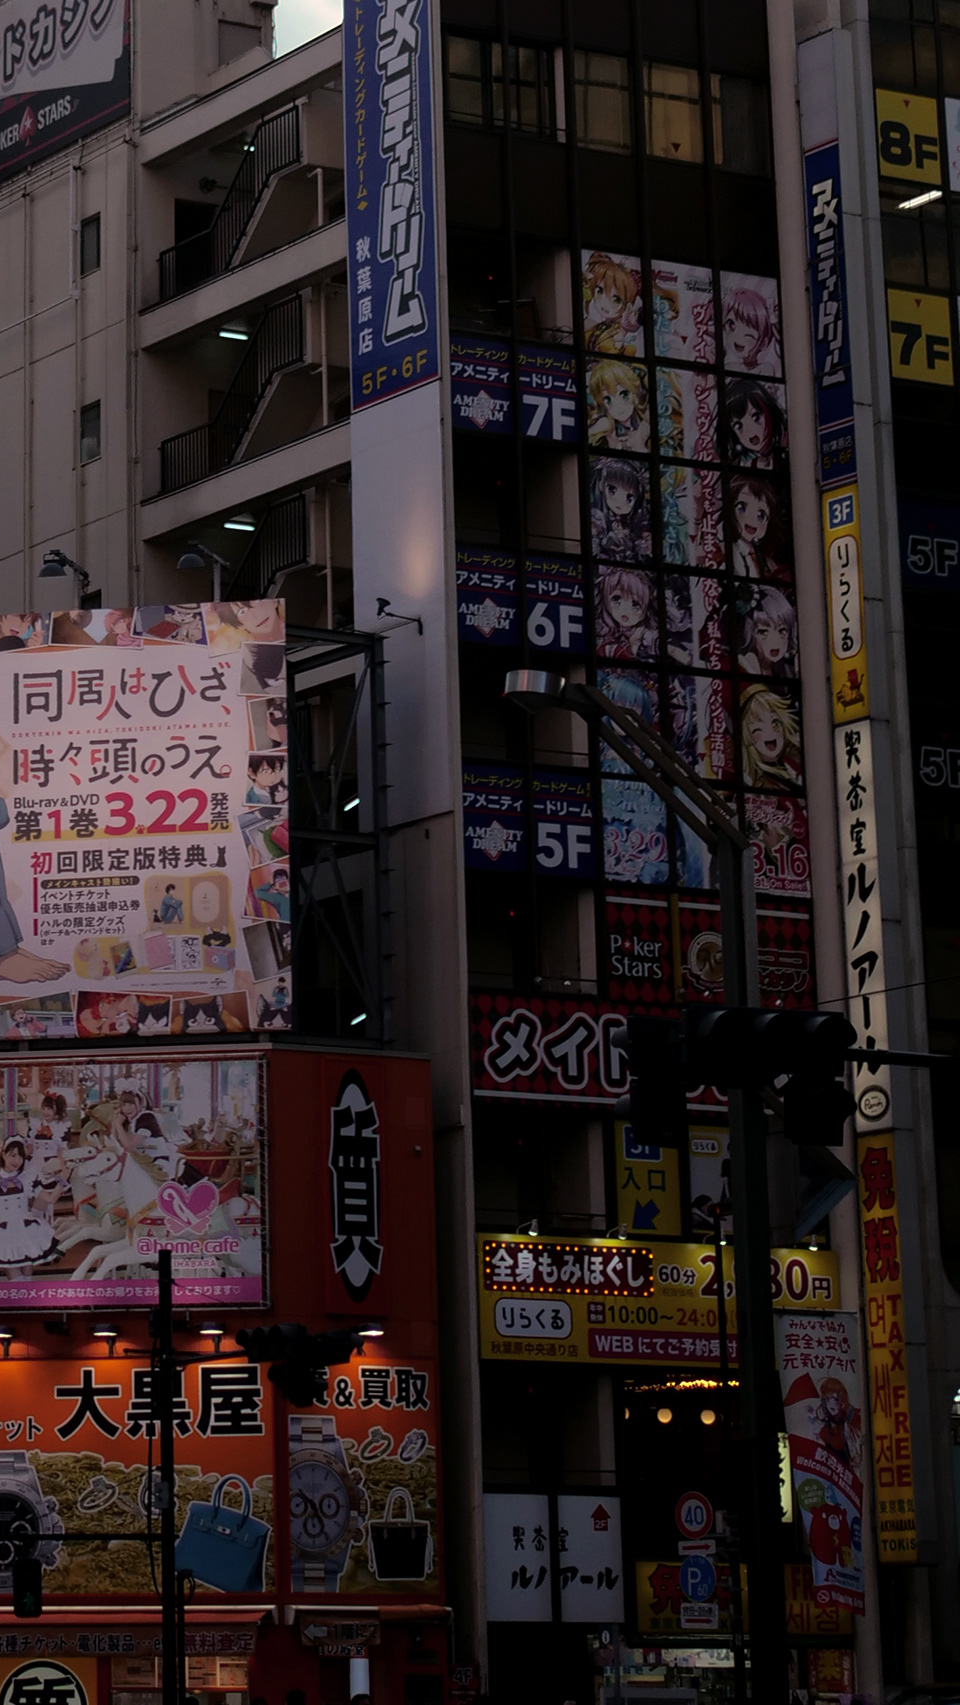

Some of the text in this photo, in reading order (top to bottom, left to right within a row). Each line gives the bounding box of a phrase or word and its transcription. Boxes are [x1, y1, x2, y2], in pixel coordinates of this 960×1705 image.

[37, 96, 71, 130] STARS
[880, 121, 938, 169] 8F
[890, 321, 950, 369] 7F
[522, 394, 576, 441] 7F
[831, 499, 852, 524] 3F
[906, 534, 959, 577] 5F
[837, 542, 854, 652] りらくる
[526, 602, 584, 648] 6F
[14, 788, 229, 841] 第1巻 3.22 発売
[30, 845, 208, 875] 初回限定版特典
[536, 822, 592, 869] 5F
[605, 827, 667, 863] 3.29
[41, 889, 111, 902] イベントチケット
[41, 915, 125, 928] ハルの限定グッズ
[611, 955, 663, 979] Stars
[621, 1167, 666, 1192] 入口
[861, 1146, 900, 1284] 免税
[491, 1248, 646, 1288] 全身もみほぐし
[657, 1265, 697, 1285] 60分
[501, 1307, 565, 1331] りらくる
[594, 1334, 635, 1353] WEB
[783, 1353, 856, 1374] 元気なアキバ
[54, 1367, 265, 1440] 大黒屋
[311, 1364, 430, 1412] &買取
[886, 1294, 913, 1488] TAX FREE
[594, 1519, 608, 1529] 2F
[684, 1504, 704, 1526] 40
[511, 1565, 619, 1590] ルノアール
[688, 1566, 701, 1596] P
